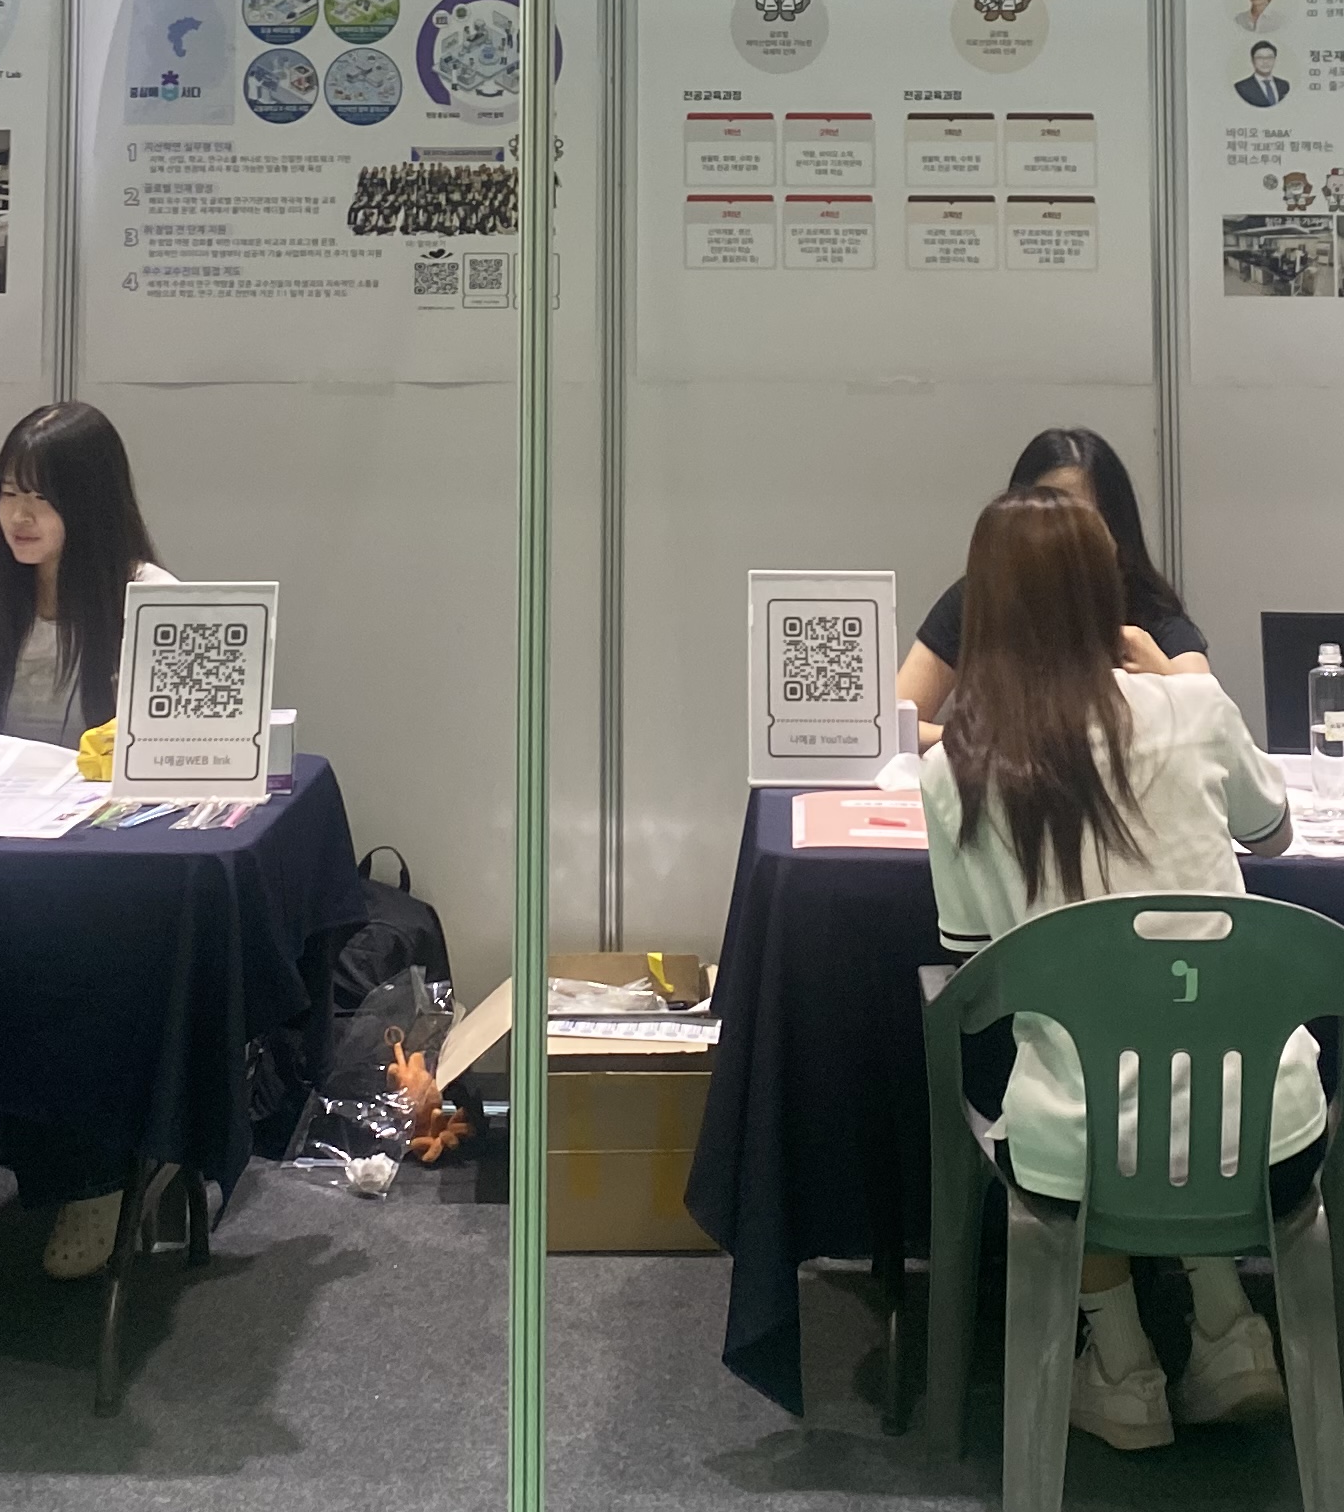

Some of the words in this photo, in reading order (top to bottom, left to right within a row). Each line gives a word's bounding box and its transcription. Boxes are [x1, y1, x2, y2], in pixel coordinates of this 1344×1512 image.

[127, 143, 137, 162] 1
[124, 187, 140, 206] 2
[124, 228, 139, 247] 3
[122, 272, 139, 291] 4
